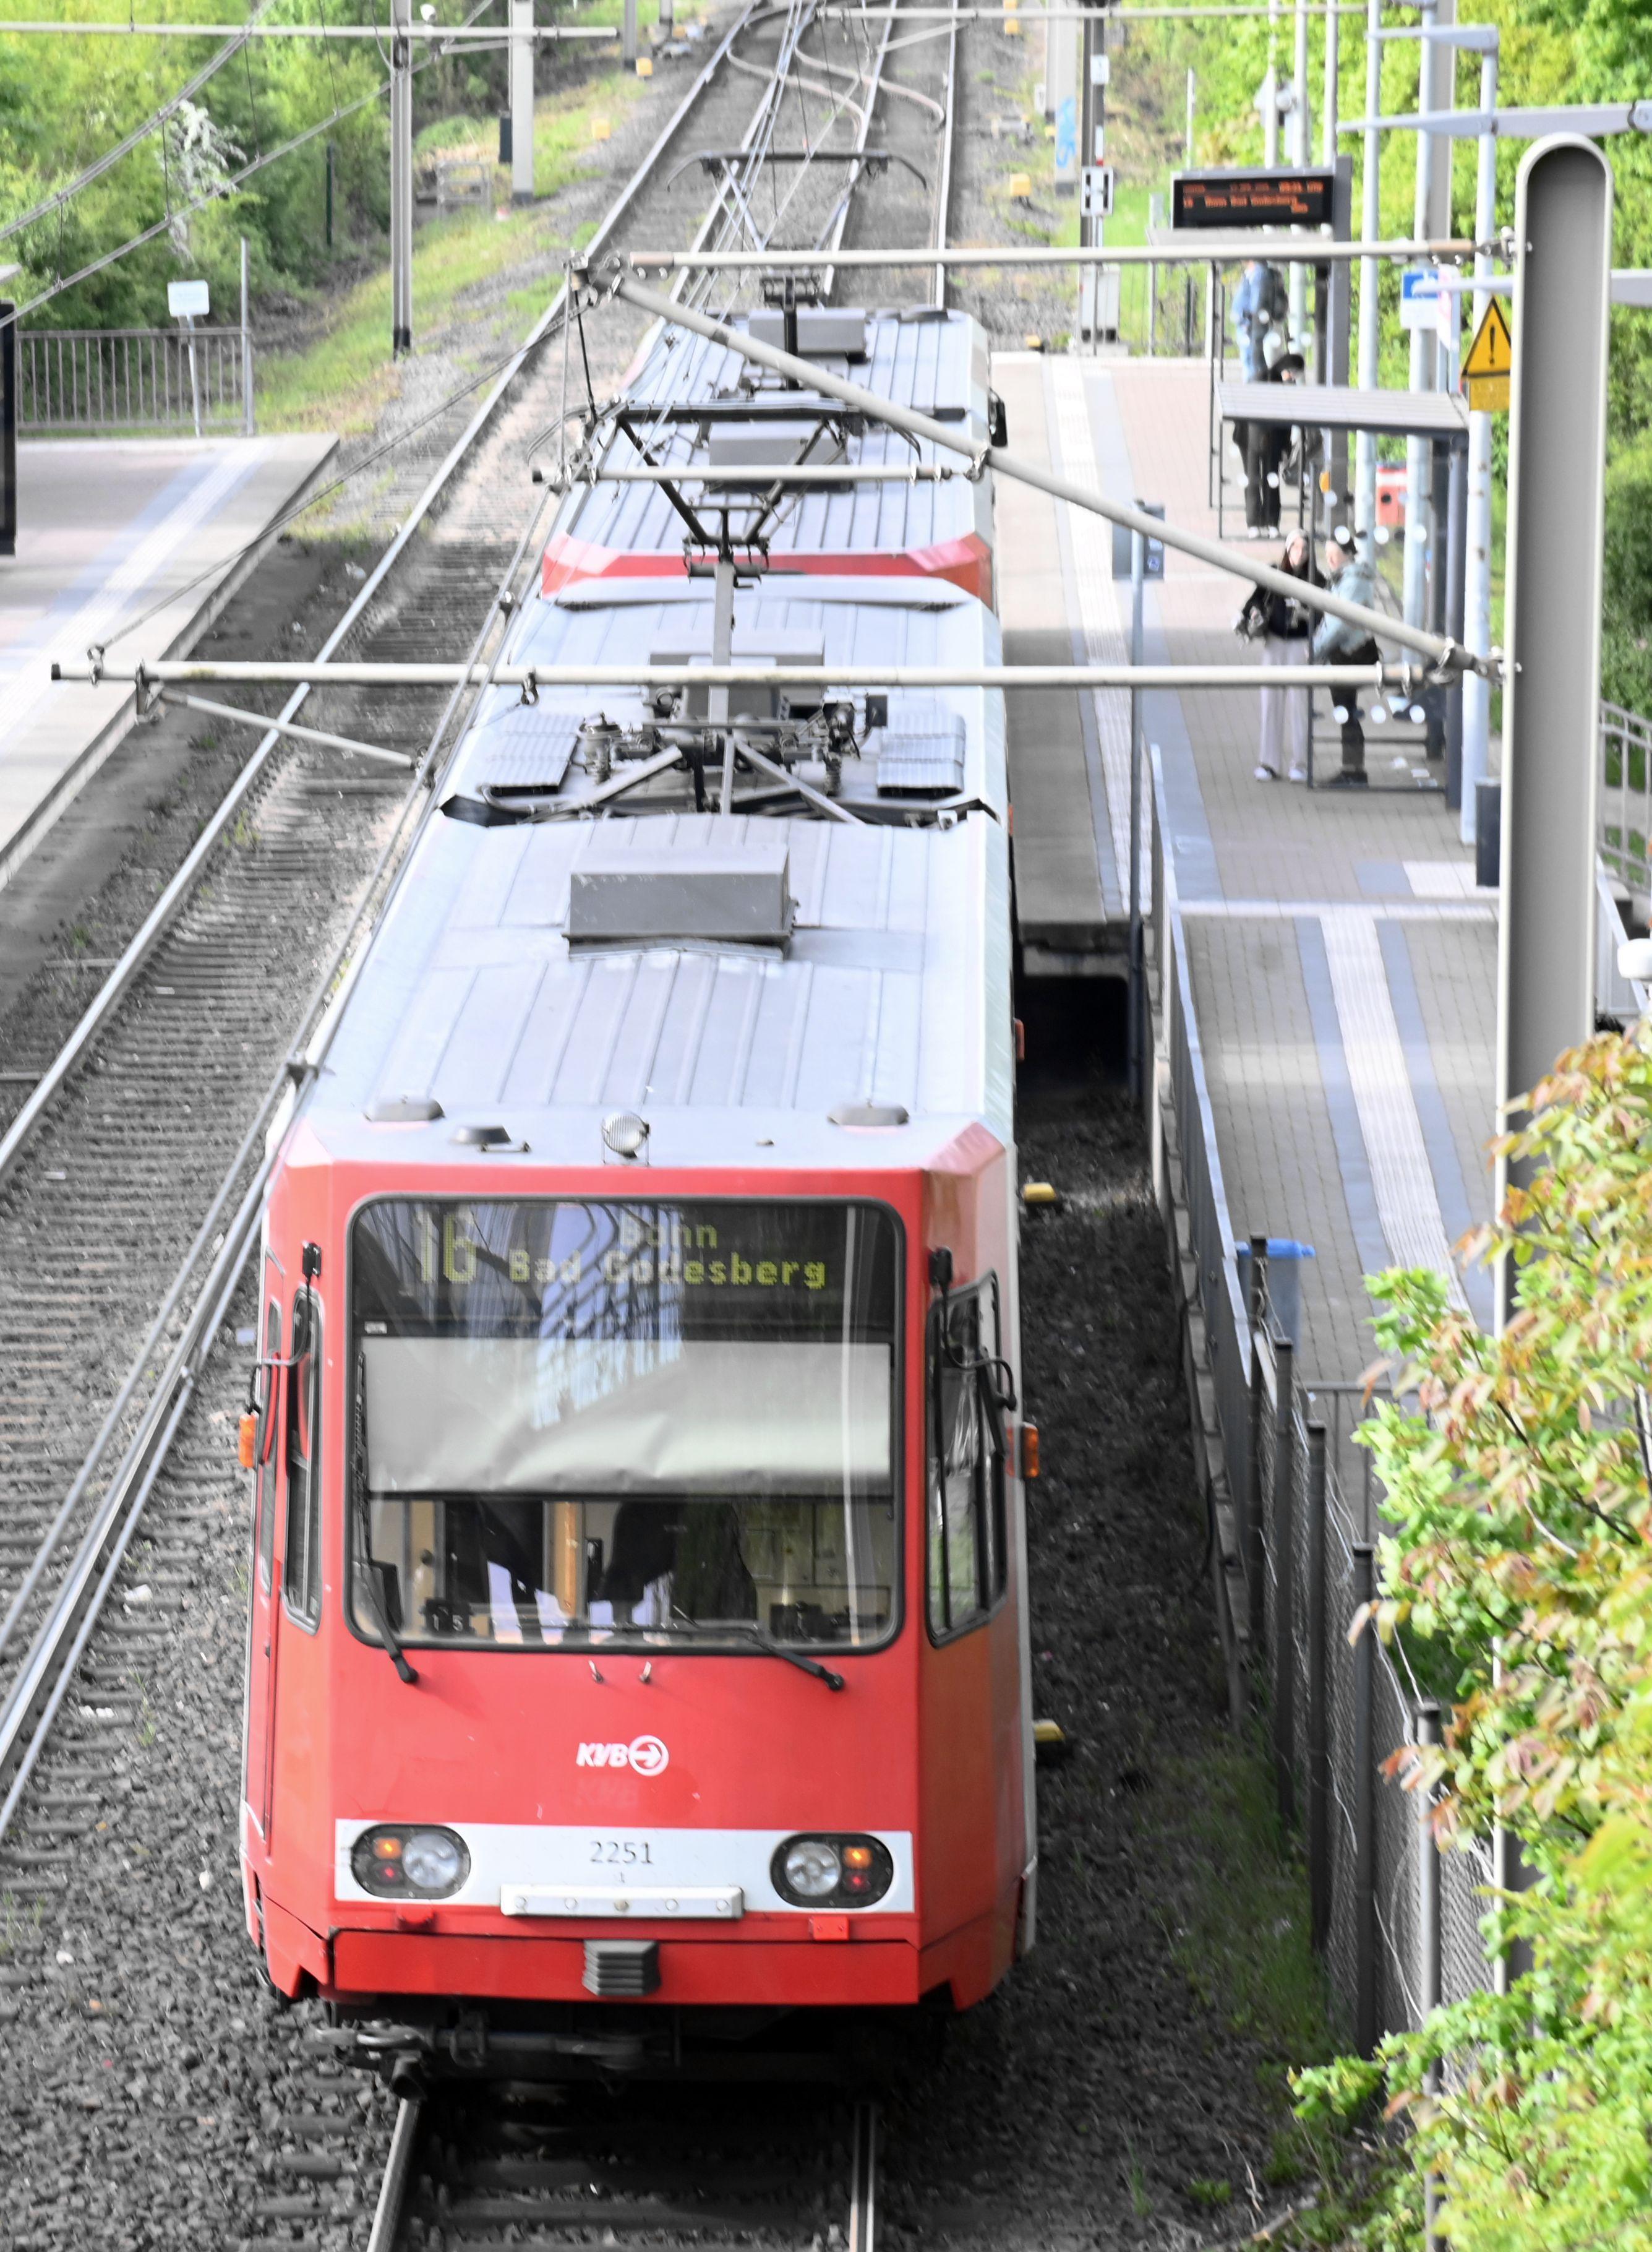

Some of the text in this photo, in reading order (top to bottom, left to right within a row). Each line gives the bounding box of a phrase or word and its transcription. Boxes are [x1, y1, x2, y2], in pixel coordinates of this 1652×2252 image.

[414, 1208, 477, 1284] 16
[508, 1248, 826, 1290] Bad Godesberg
[576, 1742, 629, 1768] KVB
[589, 1840, 655, 1865] 2251
